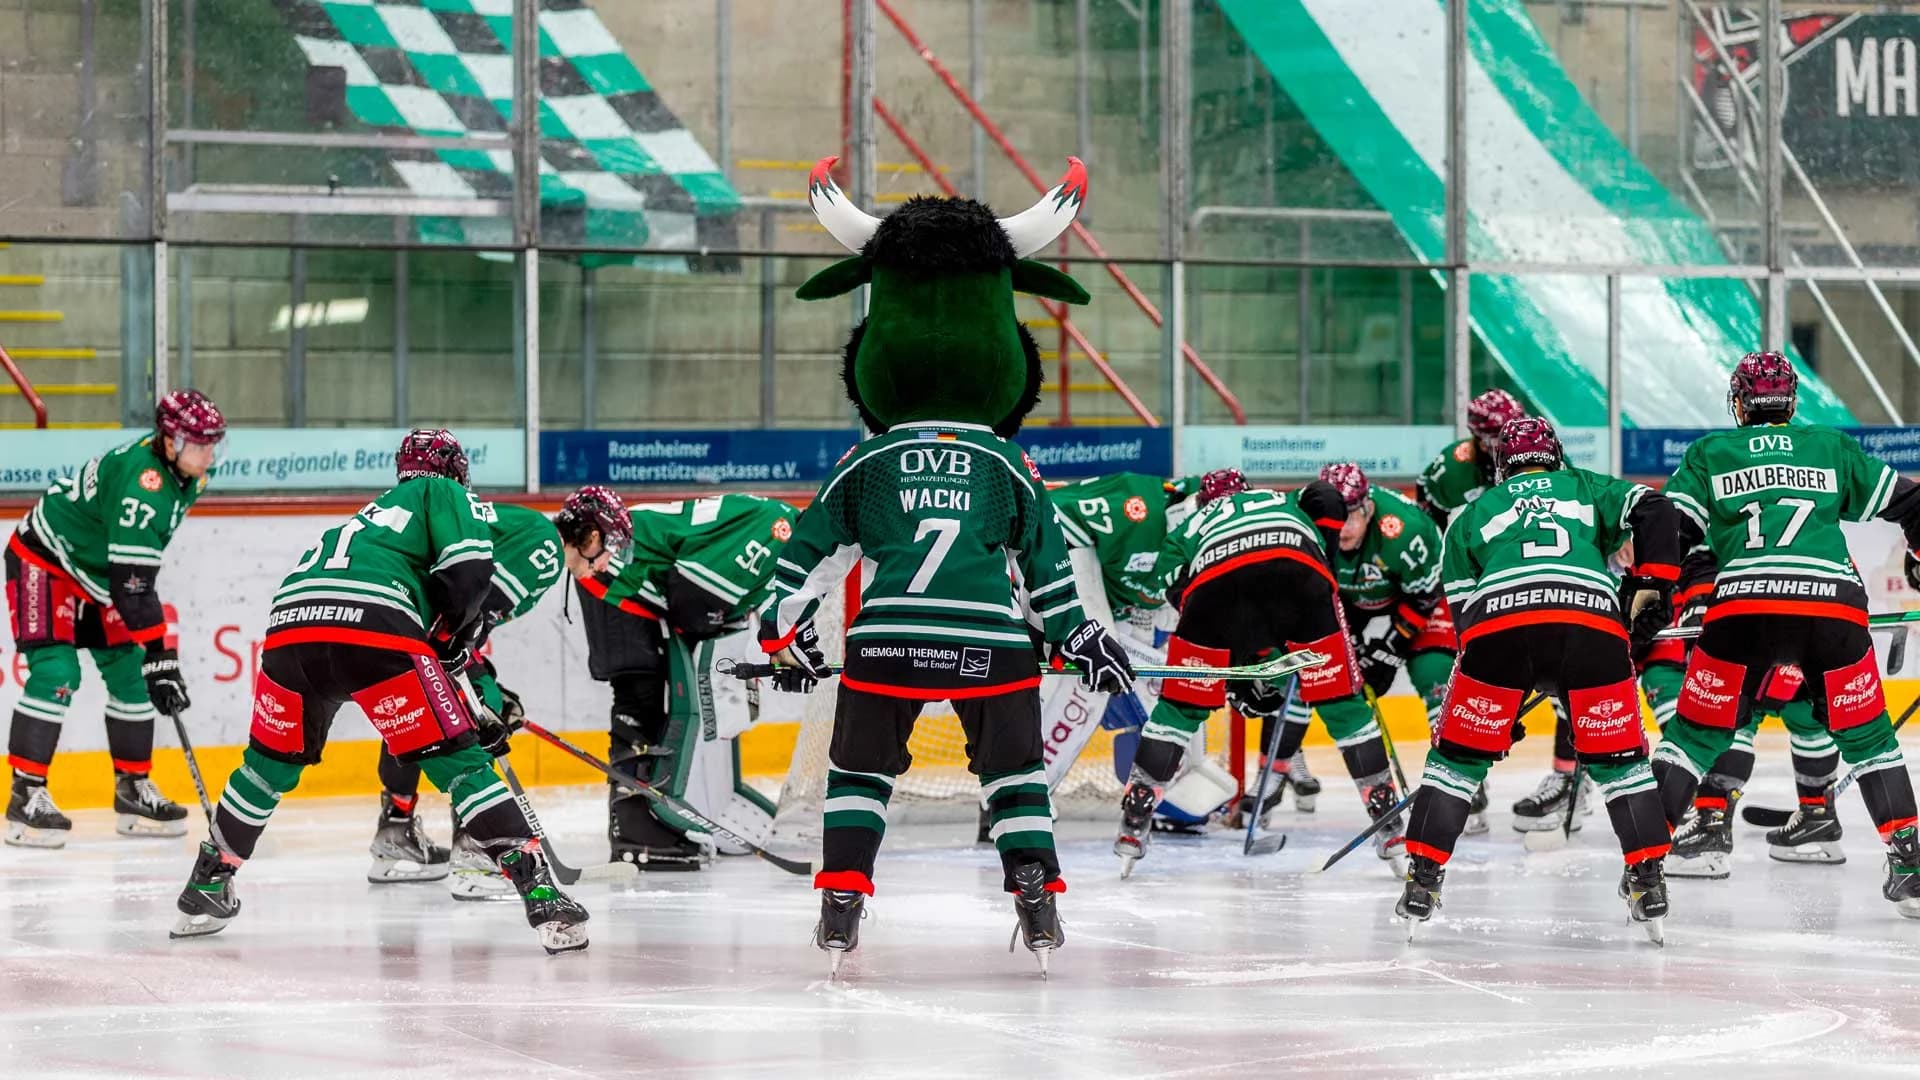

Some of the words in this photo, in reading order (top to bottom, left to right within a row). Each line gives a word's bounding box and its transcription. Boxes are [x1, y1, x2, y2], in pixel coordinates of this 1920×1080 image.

[608, 440, 711, 458] Rosenheimer
[1749, 435, 1793, 453] OVB
[0, 468, 42, 482] asse
[257, 449, 347, 481] regionale
[900, 449, 972, 476] OVB
[1508, 478, 1552, 493] OVB
[1722, 468, 1827, 495] DAXLBERGER
[119, 497, 156, 529] 37
[900, 488, 971, 513] WACKI
[1078, 497, 1114, 534] 67
[1739, 498, 1816, 549] 17
[906, 518, 961, 594] 7
[1188, 531, 1303, 578] ROSENHEIM
[1400, 534, 1429, 571] 13
[1486, 588, 1612, 614] ROSENHEIM
[1717, 579, 1837, 599] ROSENHEIM
[861, 647, 905, 658] CHIEMGAU
[908, 648, 958, 660] THERMEN
[913, 659, 928, 668] Bad
[930, 660, 956, 671] Endorf
[1452, 703, 1510, 727] Flötzinger
[1577, 712, 1635, 731] Flötzinger
